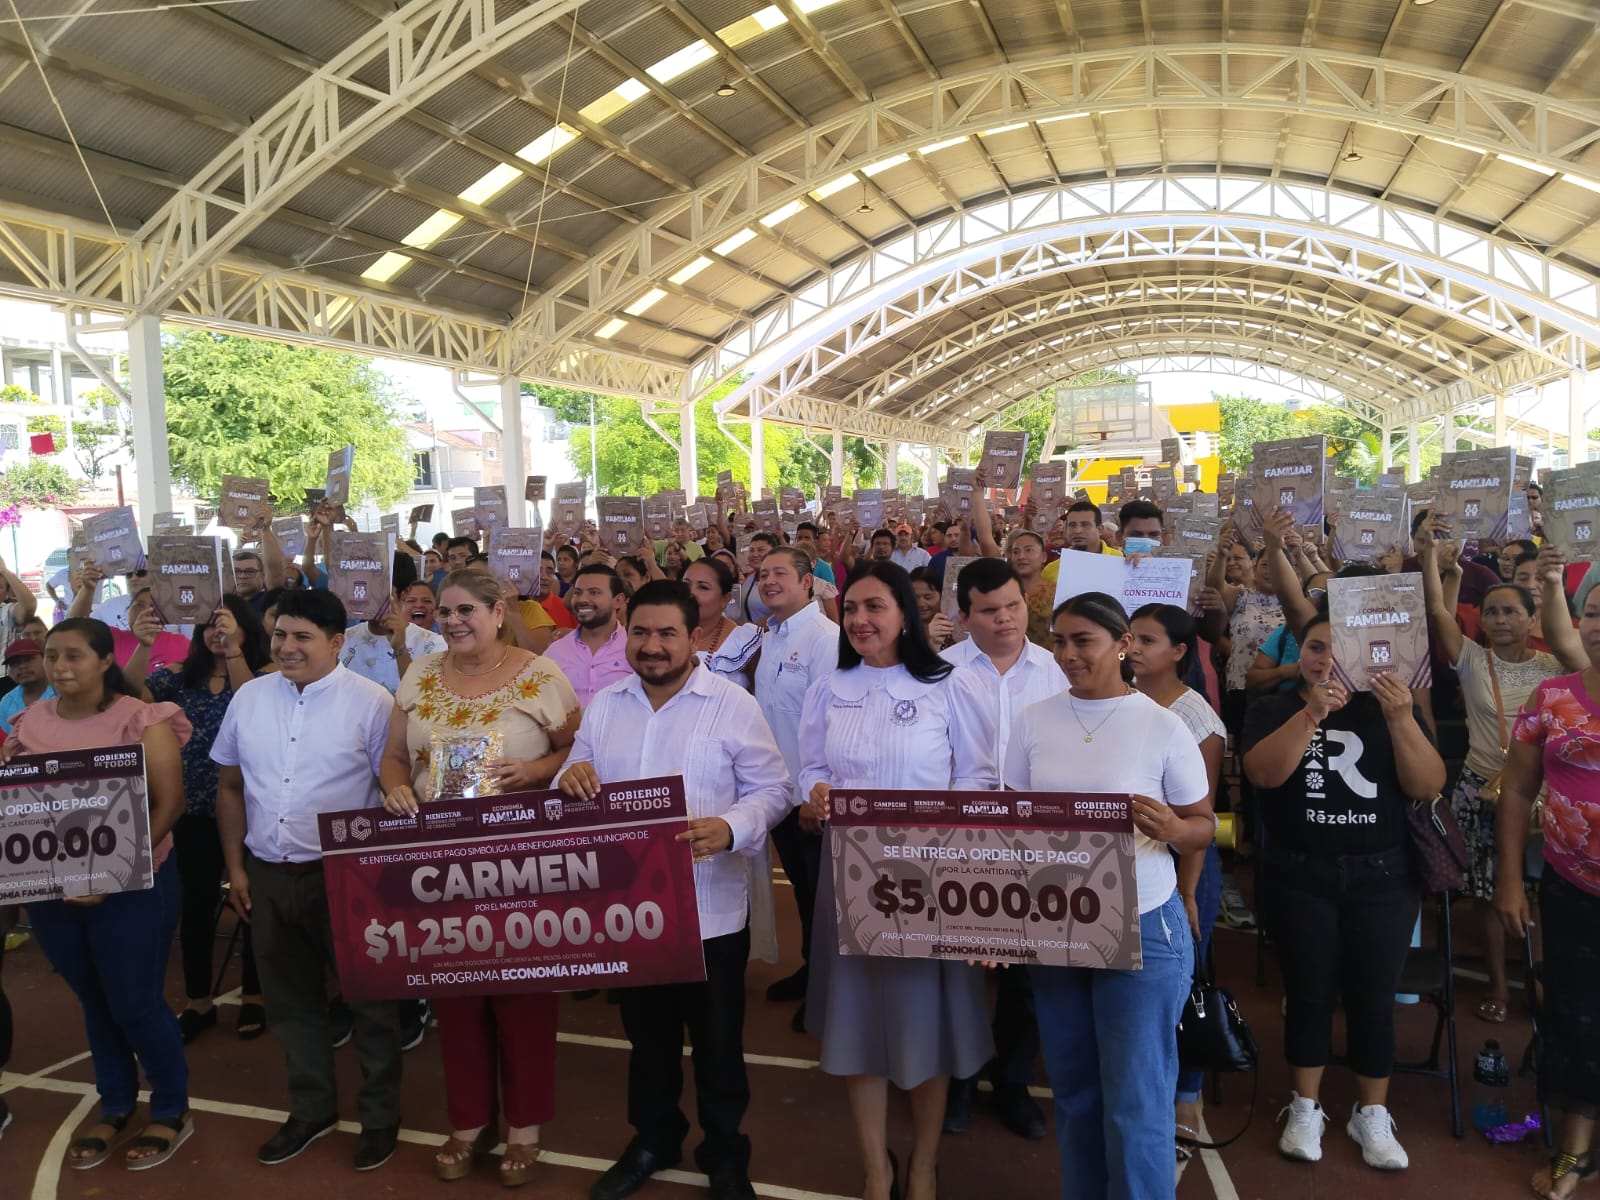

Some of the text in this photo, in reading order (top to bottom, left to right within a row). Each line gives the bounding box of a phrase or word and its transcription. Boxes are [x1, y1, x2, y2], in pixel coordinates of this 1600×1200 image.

[1264, 464, 1312, 478] FAMILIAR
[1450, 478, 1500, 488] FAMILIAR
[1554, 496, 1600, 510] FAMILIA
[1350, 511, 1392, 522] FAMILIAR
[161, 564, 209, 574] FAMILIAR
[340, 560, 382, 570] FAMILIAR
[1124, 589, 1182, 599] CONSTANCIA
[1346, 612, 1410, 627] FAMILIAR
[94, 752, 136, 762] GOBIERNO
[104, 759, 137, 768] TODOS
[1326, 730, 1377, 798] R
[609, 786, 670, 802] GOBIERNO
[5, 801, 50, 816] ORDEN
[52, 800, 70, 811] DE
[72, 796, 108, 808] PAGO
[622, 798, 672, 812] TODOS
[962, 805, 1008, 814] FAMILIAR
[1074, 802, 1128, 810] GOBIERNO
[426, 811, 462, 820] BIENESTAR
[482, 808, 535, 824] FAMILIAR
[1086, 810, 1128, 819] TODOS
[1306, 808, 1376, 824] Rēzekne
[378, 818, 418, 828] CAMPECHE
[0, 825, 116, 864] 00.00
[359, 830, 648, 865] SE ENTREGA ORDEN DE PAGO SIMBÓLICA A BENEFICIARIOS DEL MUNICIPIO DE
[884, 845, 1090, 864] SE ENTREGA ORDEN DE PAGO
[64, 872, 108, 883] PROGRAMA
[411, 851, 600, 902] CARMEN
[974, 867, 1016, 876] CANTIDAD
[475, 904, 490, 912] POR
[500, 901, 527, 910] MONTO
[528, 900, 538, 908] DE
[873, 874, 1100, 924] $5,000.00
[364, 901, 664, 964] $1,250,000.00
[882, 932, 902, 940] PARA
[906, 933, 958, 943] ACTIVIDADES
[960, 936, 1019, 946] PRODUCTIVAS
[1038, 940, 1090, 950] PROGRAMA
[932, 944, 1038, 959] ECONOMÍA FAMILIAR
[406, 961, 629, 986] DEL PROGRAMA ECONOMÍA FAMILIAR
